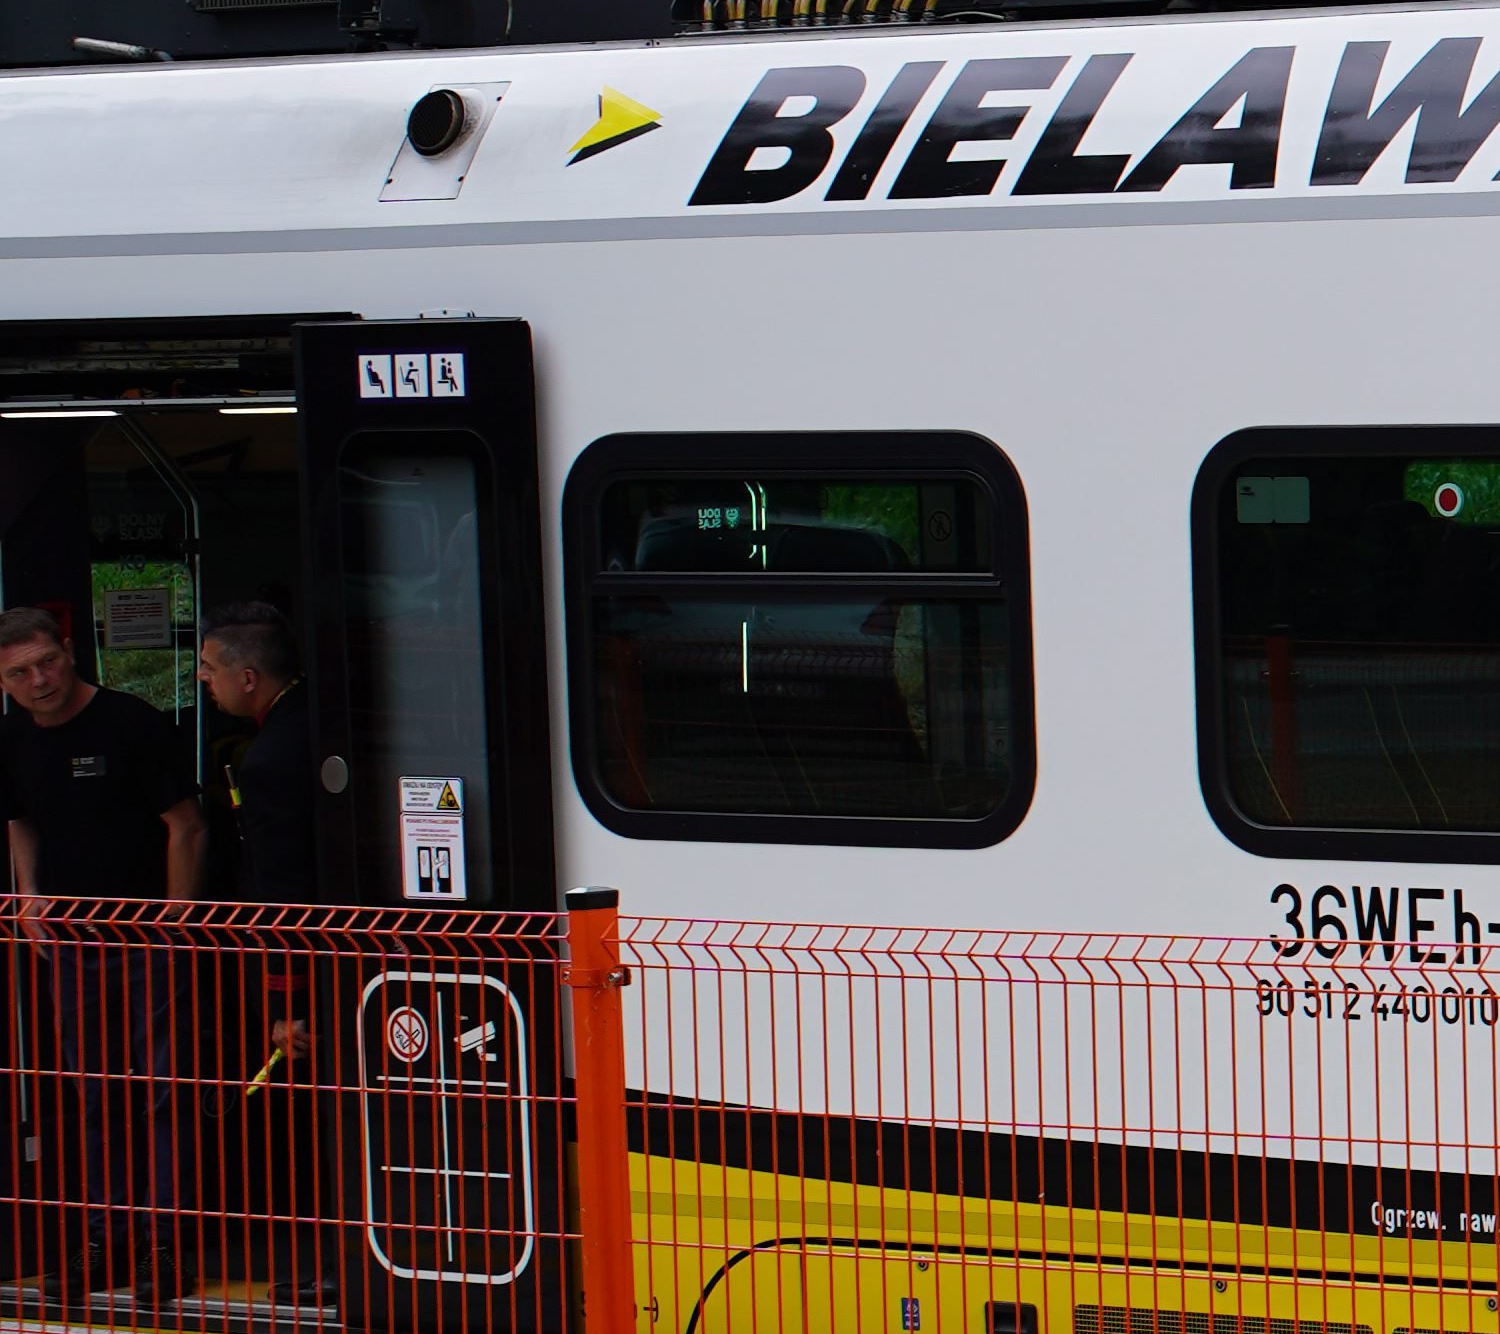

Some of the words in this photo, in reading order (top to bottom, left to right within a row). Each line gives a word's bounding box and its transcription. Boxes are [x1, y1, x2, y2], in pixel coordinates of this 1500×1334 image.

[1256, 979, 1293, 1017] 90
[1303, 981, 1333, 1019] 51
[1371, 984, 1431, 1023] 440
